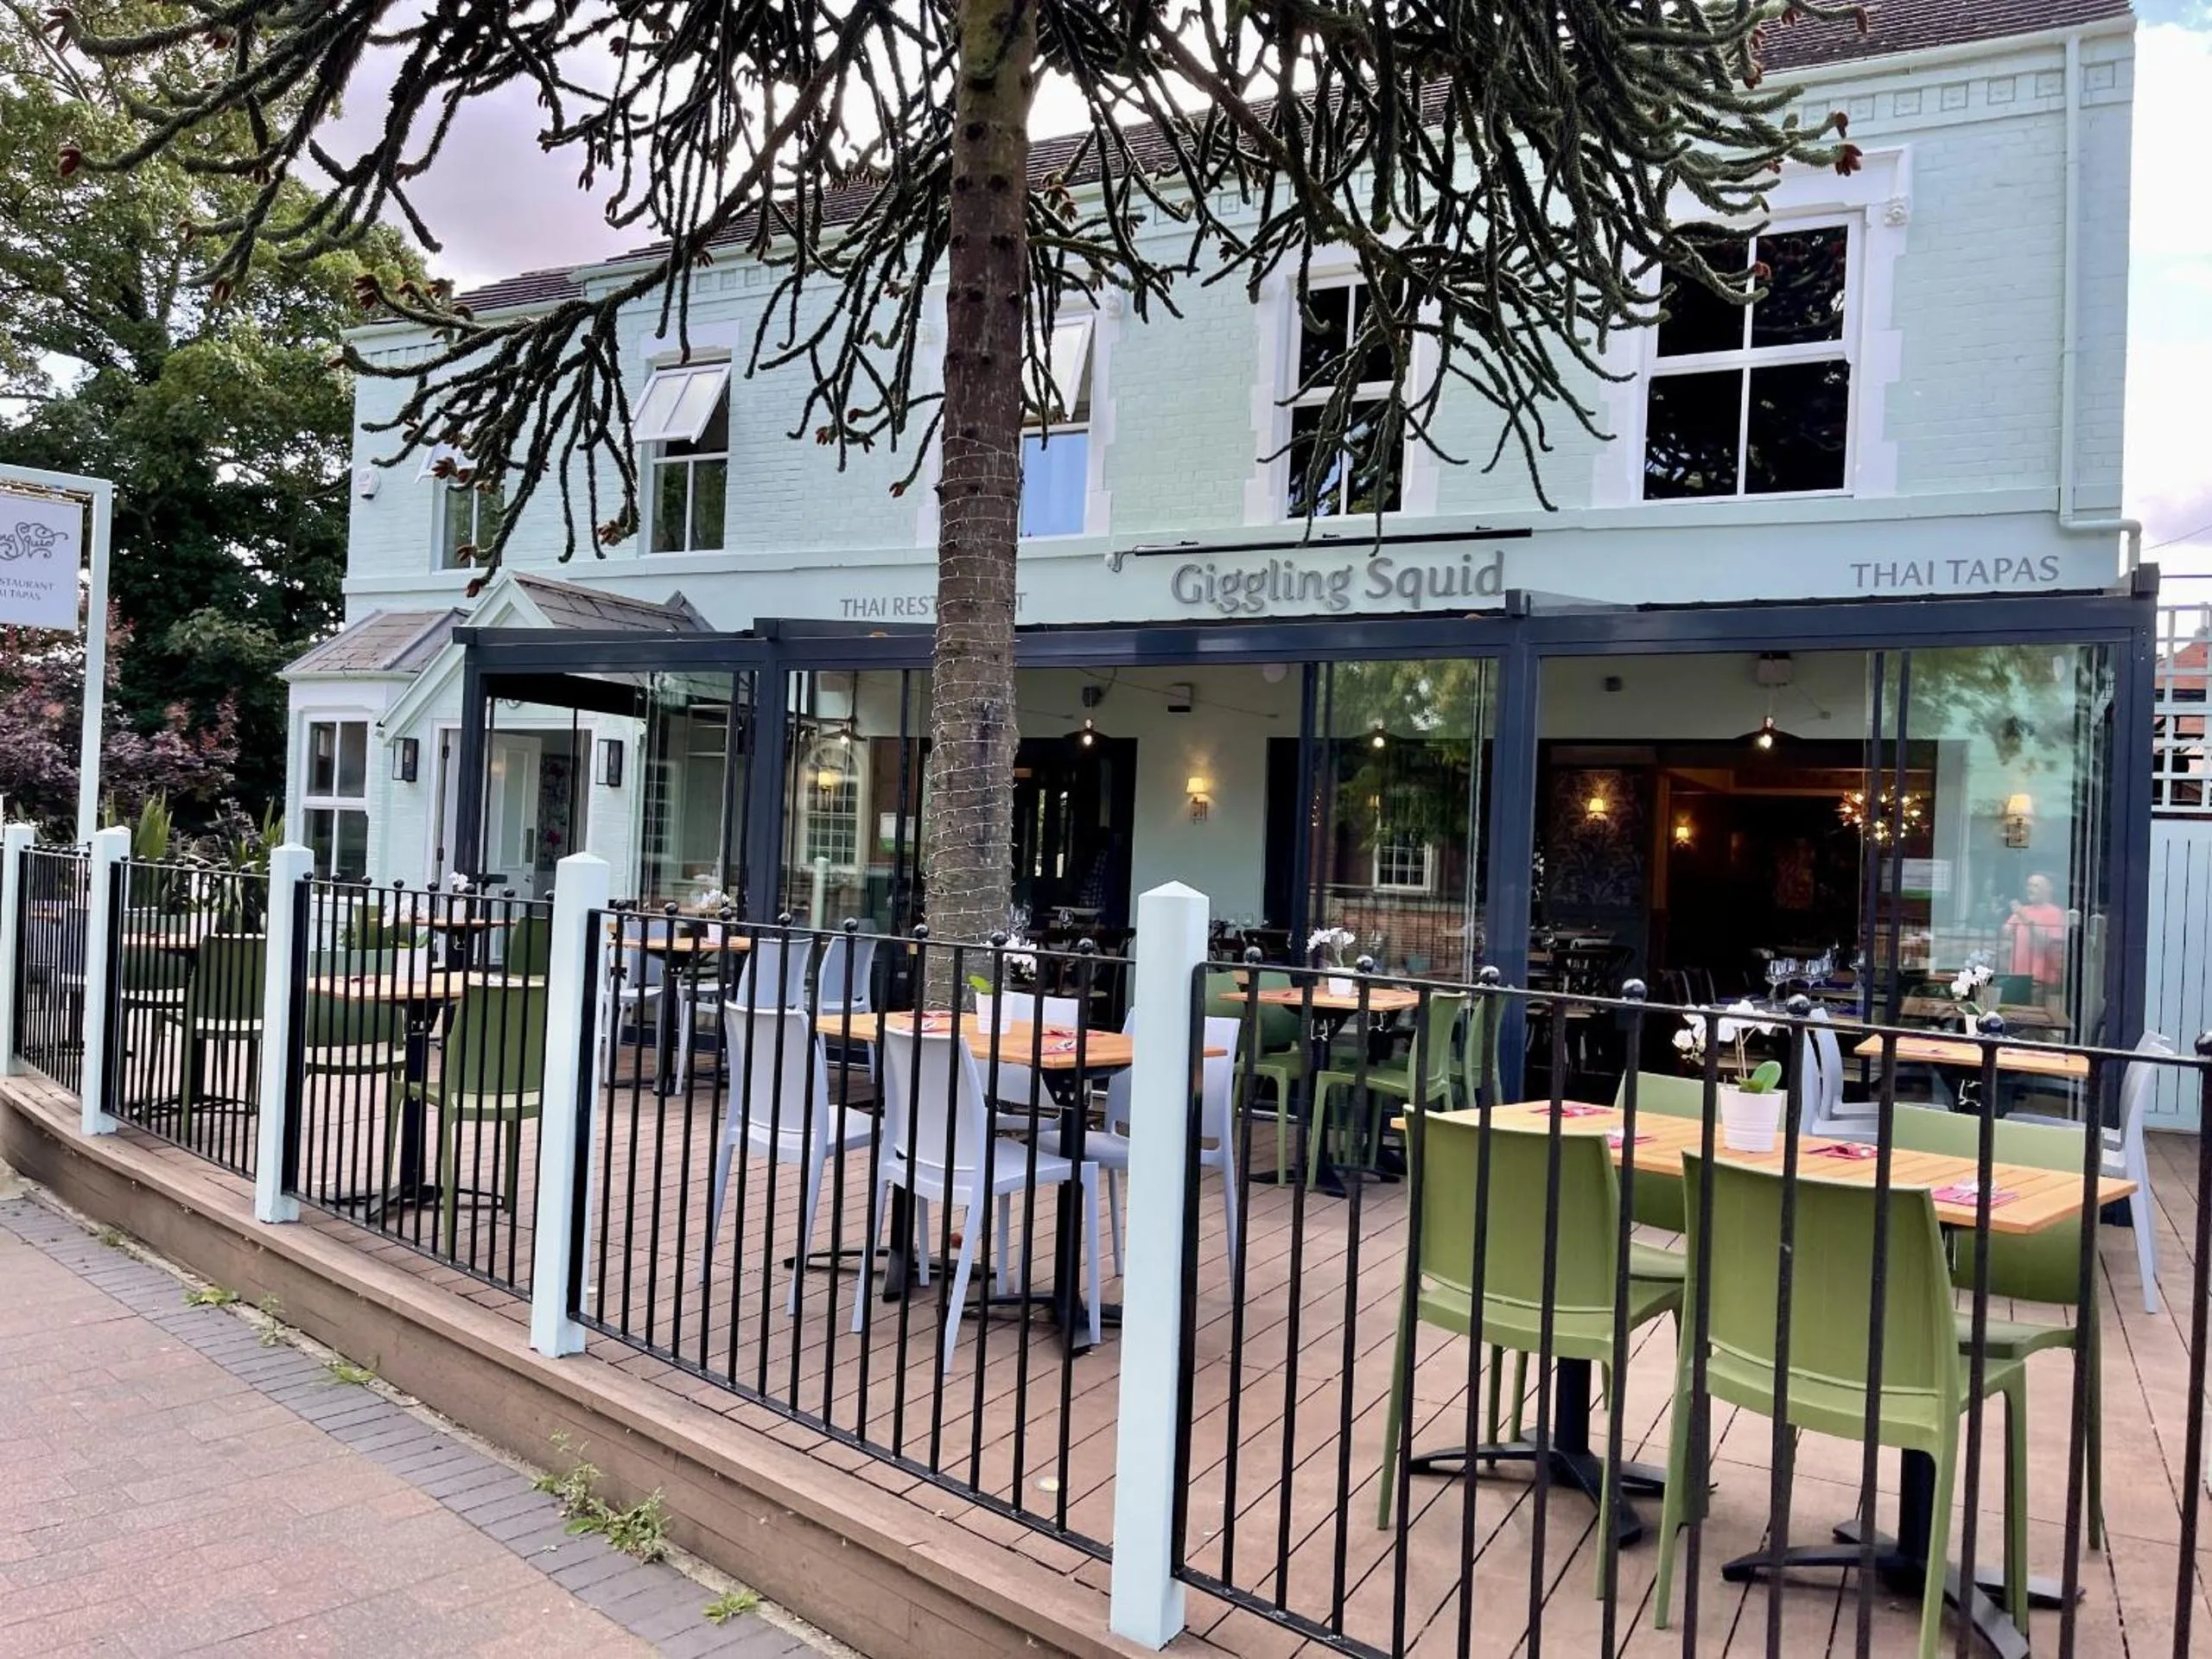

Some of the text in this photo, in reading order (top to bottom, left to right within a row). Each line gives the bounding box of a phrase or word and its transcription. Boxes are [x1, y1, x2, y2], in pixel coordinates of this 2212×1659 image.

[1172, 550, 1505, 613] Giggling Squid
[1850, 555, 2060, 588] THAI TAPAS
[841, 597, 887, 617] THAI
